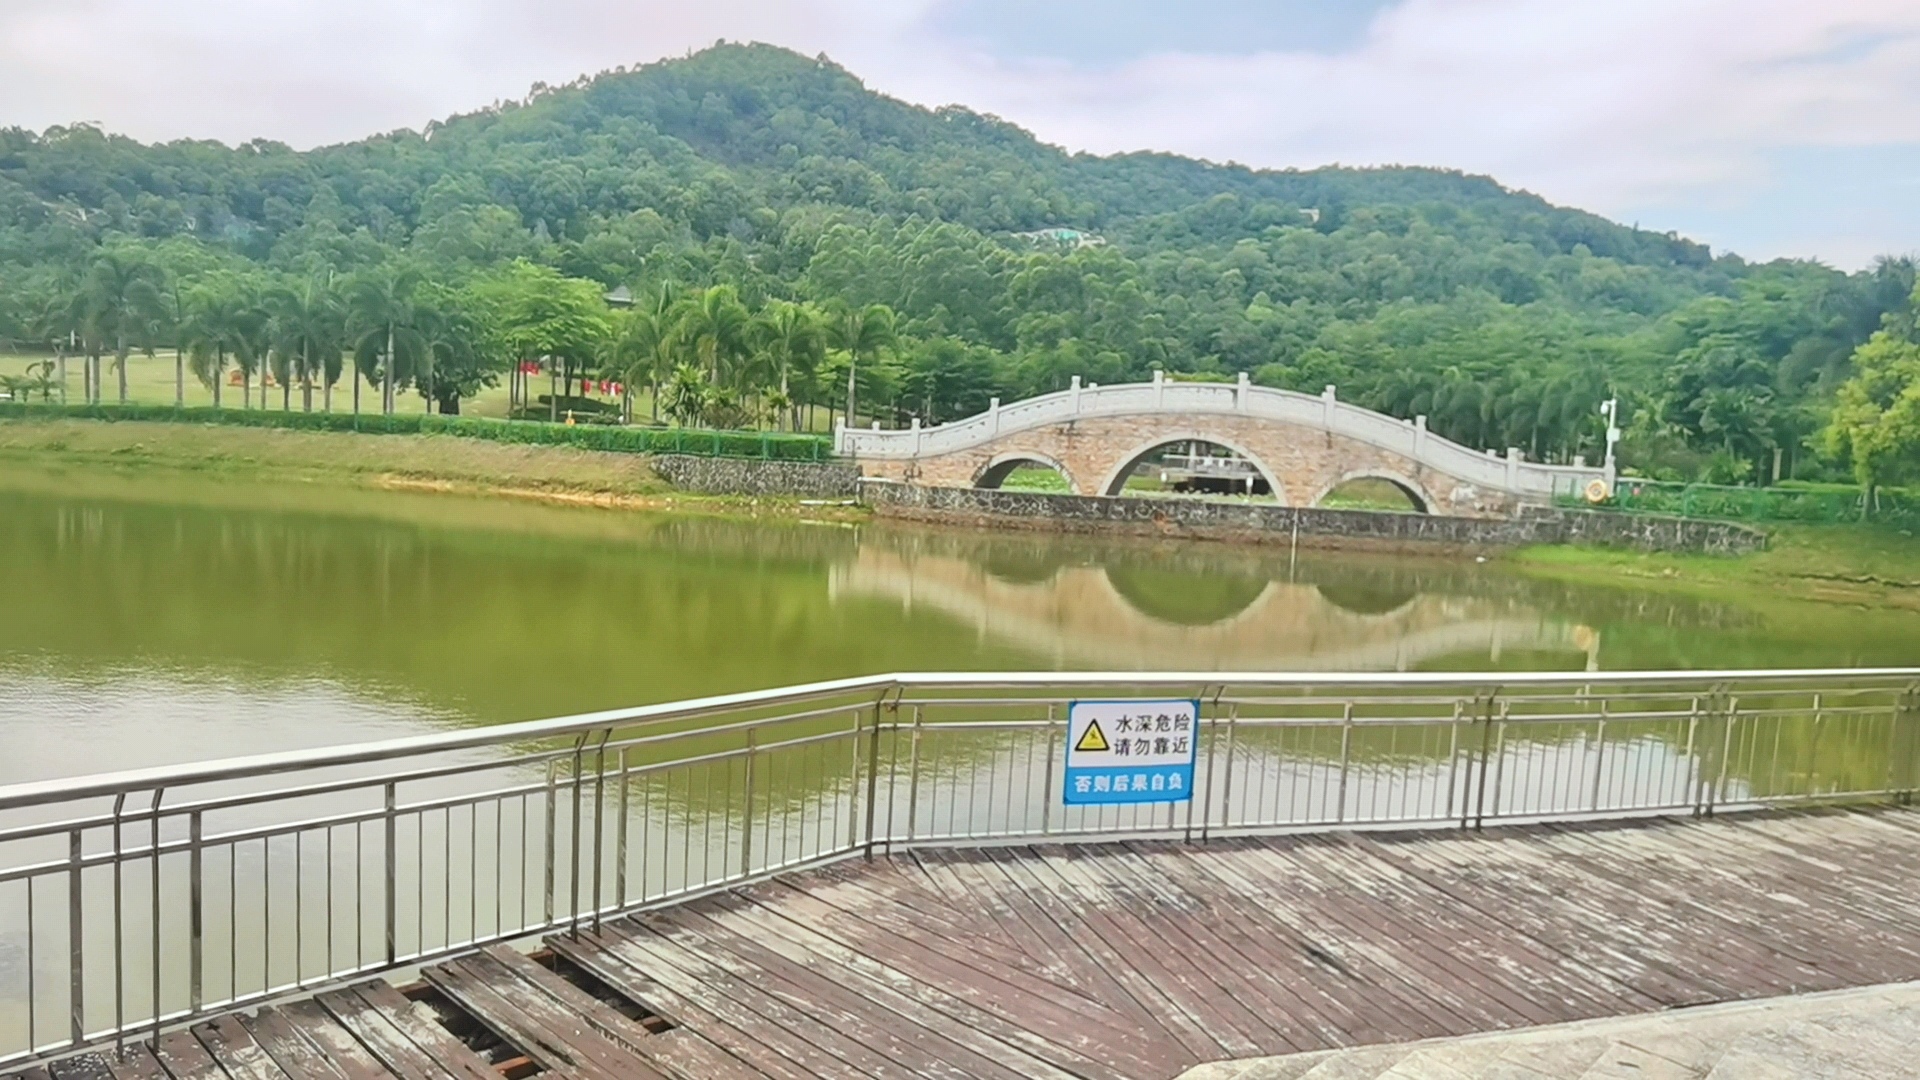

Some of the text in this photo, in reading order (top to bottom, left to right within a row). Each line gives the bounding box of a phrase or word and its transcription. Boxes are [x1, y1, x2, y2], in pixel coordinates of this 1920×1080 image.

[1115, 713, 1190, 733] 水深危险
[1114, 736, 1188, 756] 请勿靠近
[1075, 772, 1182, 793] 否则后果自负
